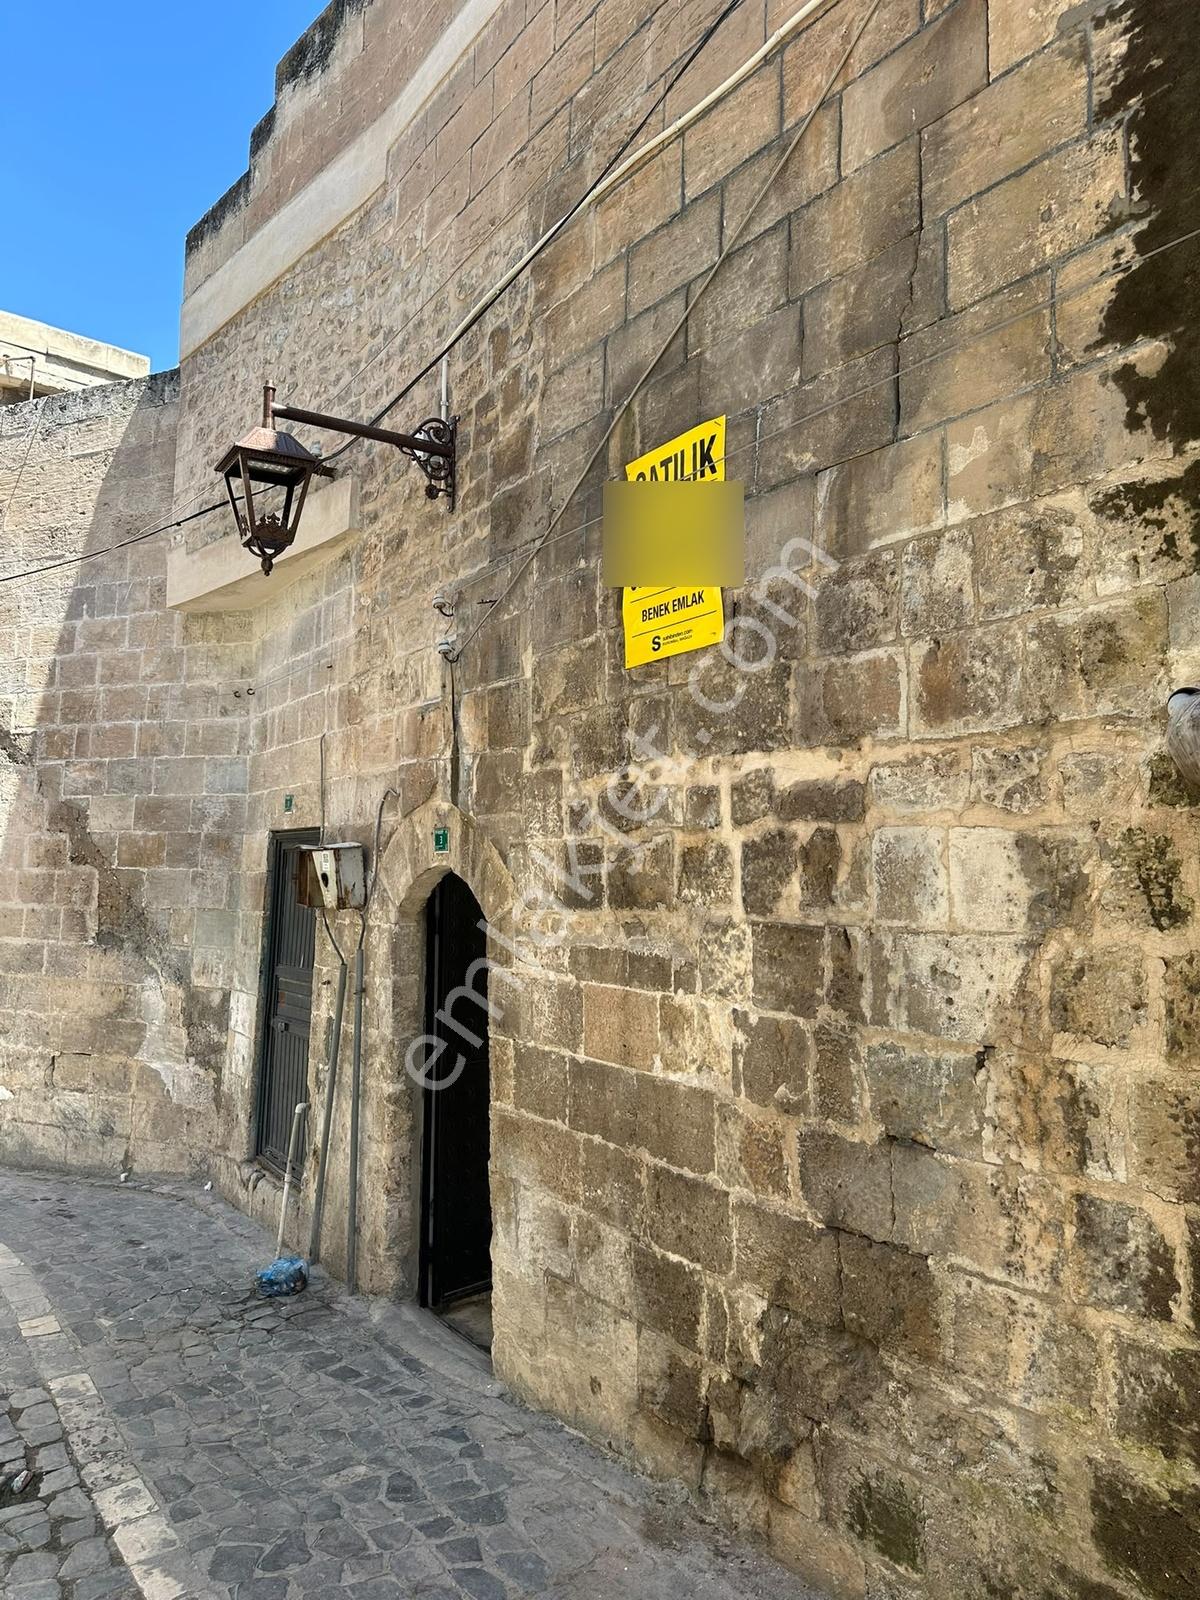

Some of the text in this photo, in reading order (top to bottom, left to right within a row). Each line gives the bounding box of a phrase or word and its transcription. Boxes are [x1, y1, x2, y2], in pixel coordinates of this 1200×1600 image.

[641, 590, 705, 622] BENEK EMLAK
[651, 635, 661, 652] S
